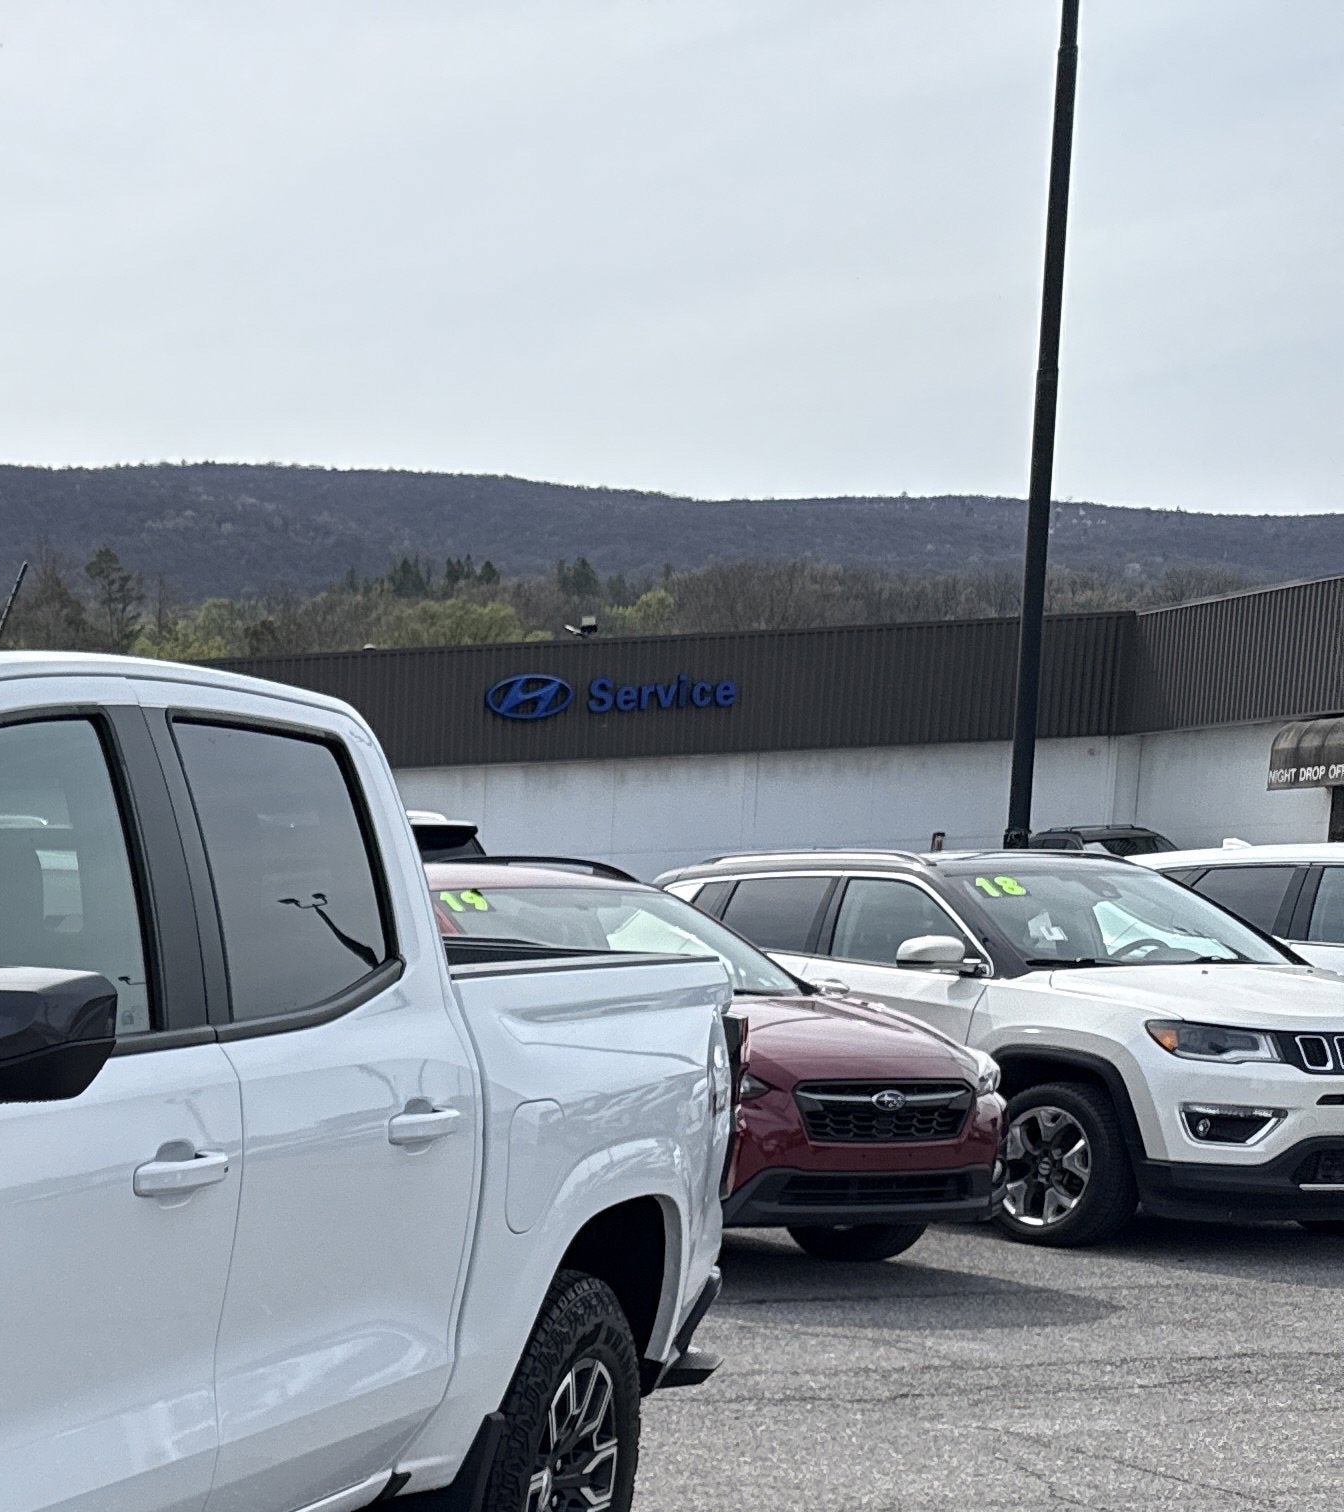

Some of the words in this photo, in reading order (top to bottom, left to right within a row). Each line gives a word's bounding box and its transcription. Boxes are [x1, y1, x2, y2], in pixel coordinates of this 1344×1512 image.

[588, 673, 736, 713] Service
[1268, 768, 1297, 783] NIGHT
[1299, 765, 1326, 782] DROP
[975, 876, 1027, 897] 18
[439, 890, 488, 912] 19
